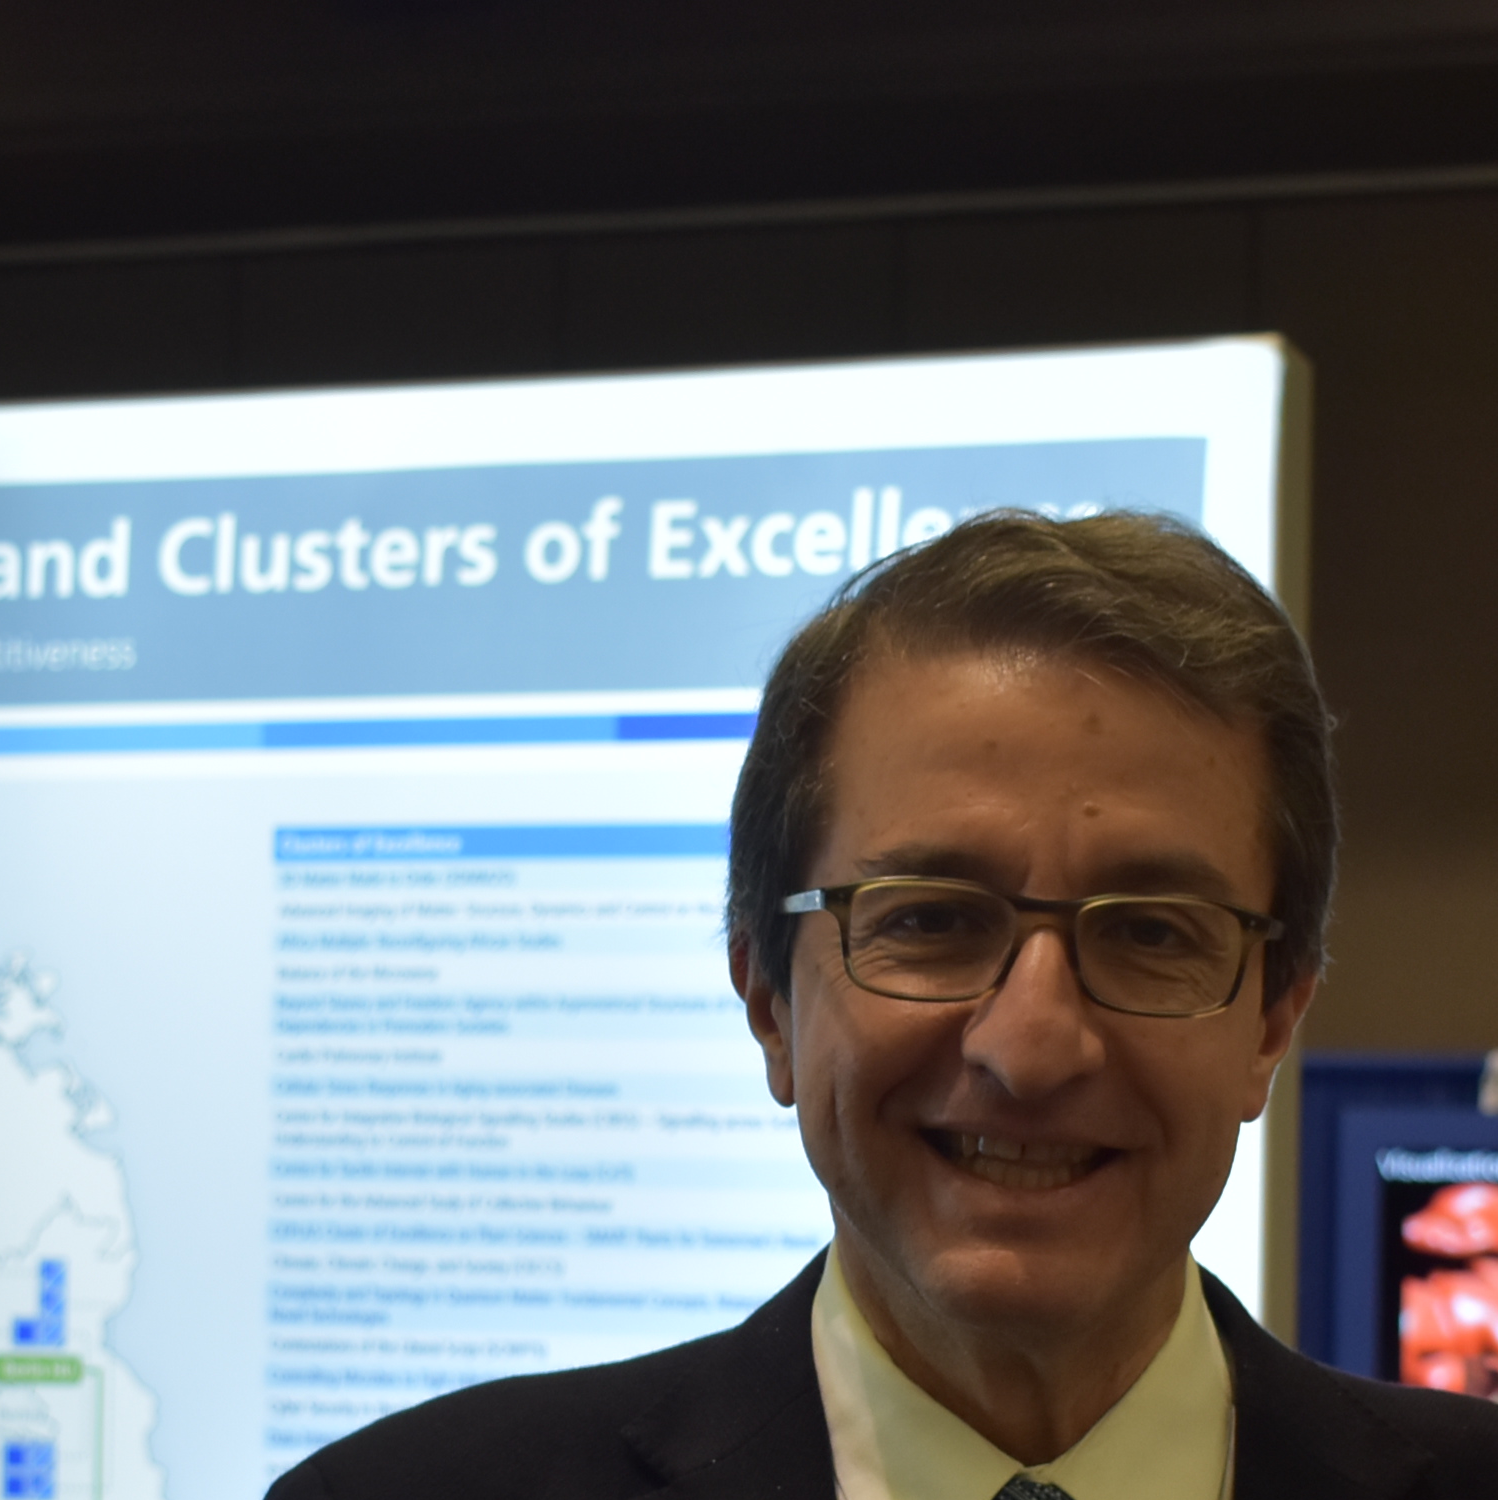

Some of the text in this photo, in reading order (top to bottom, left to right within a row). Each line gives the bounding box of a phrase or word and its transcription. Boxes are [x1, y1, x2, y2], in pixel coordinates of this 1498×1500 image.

[157, 511, 499, 596] Clusters
[523, 495, 624, 583] of
[648, 484, 1031, 579] Excelle
